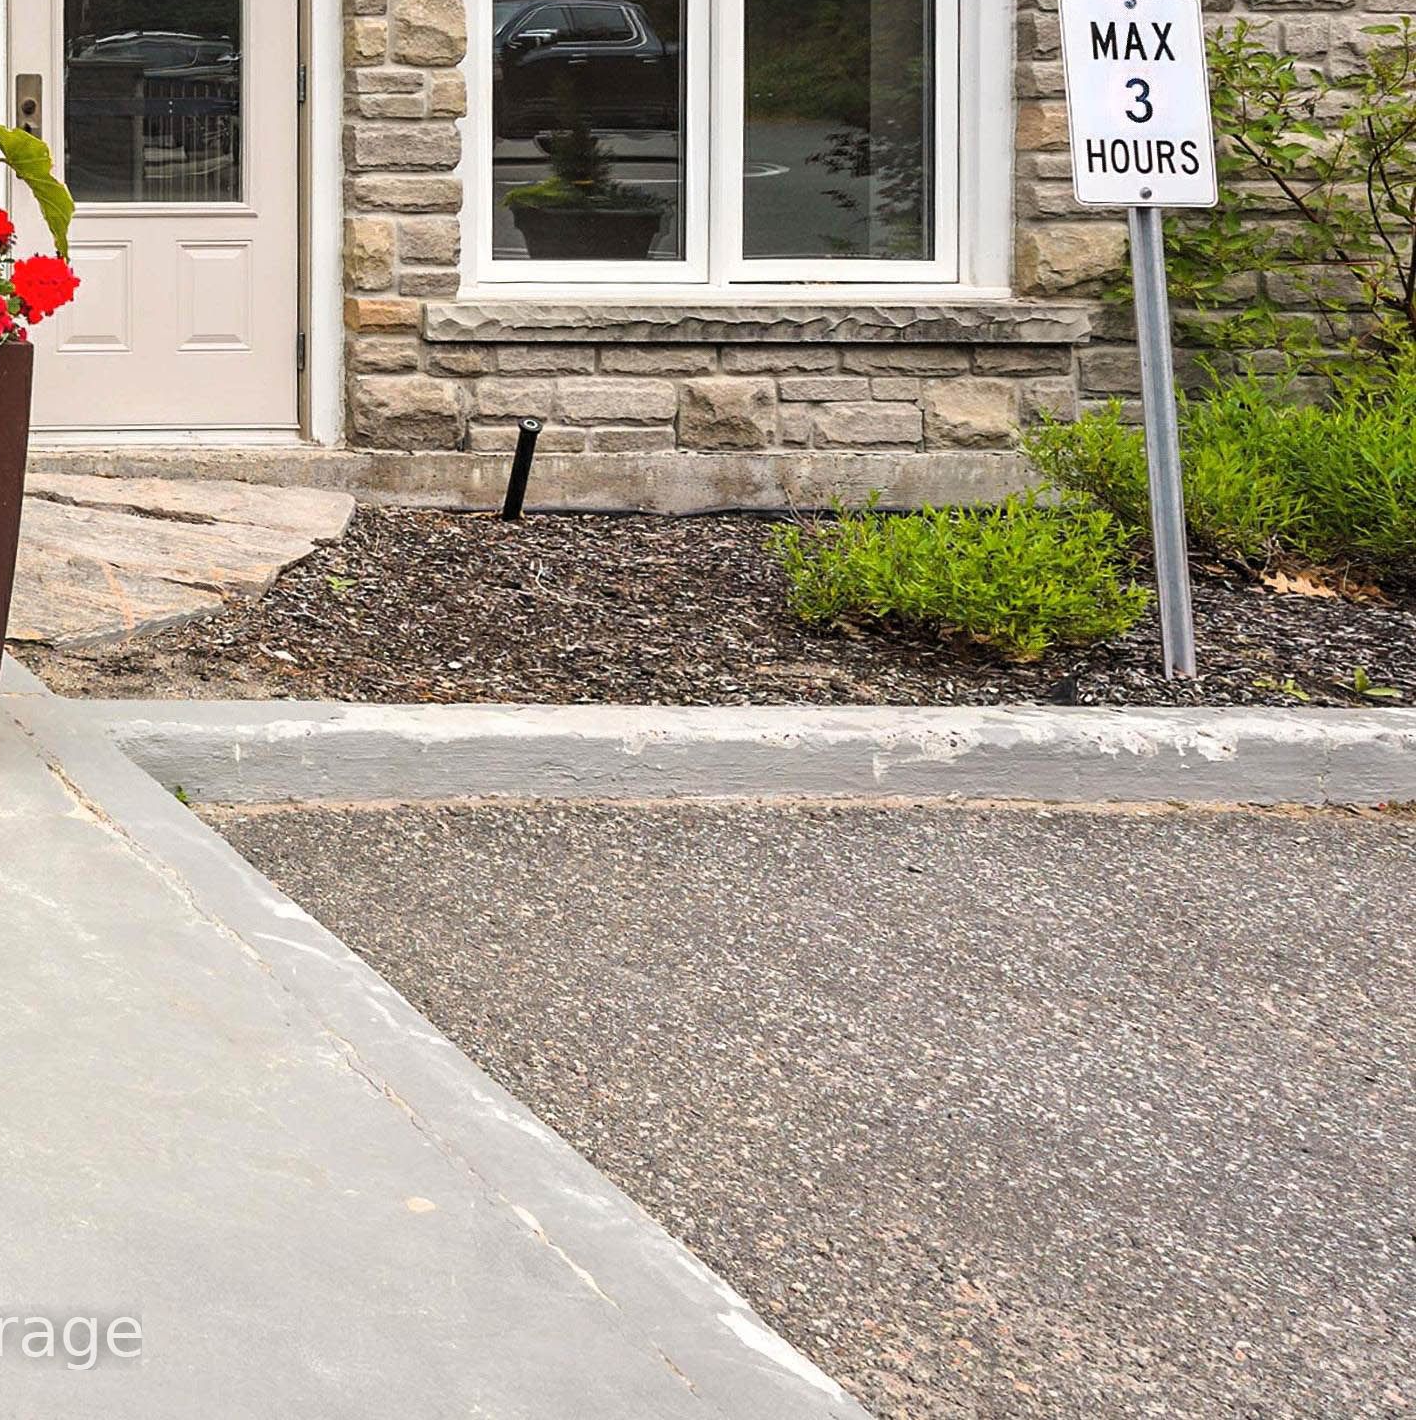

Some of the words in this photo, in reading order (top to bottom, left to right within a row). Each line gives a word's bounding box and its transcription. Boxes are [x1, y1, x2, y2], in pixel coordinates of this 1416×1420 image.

[1090, 21, 1176, 62] MAX
[1125, 78, 1154, 124] 3
[1086, 139, 1201, 175] HOURS
